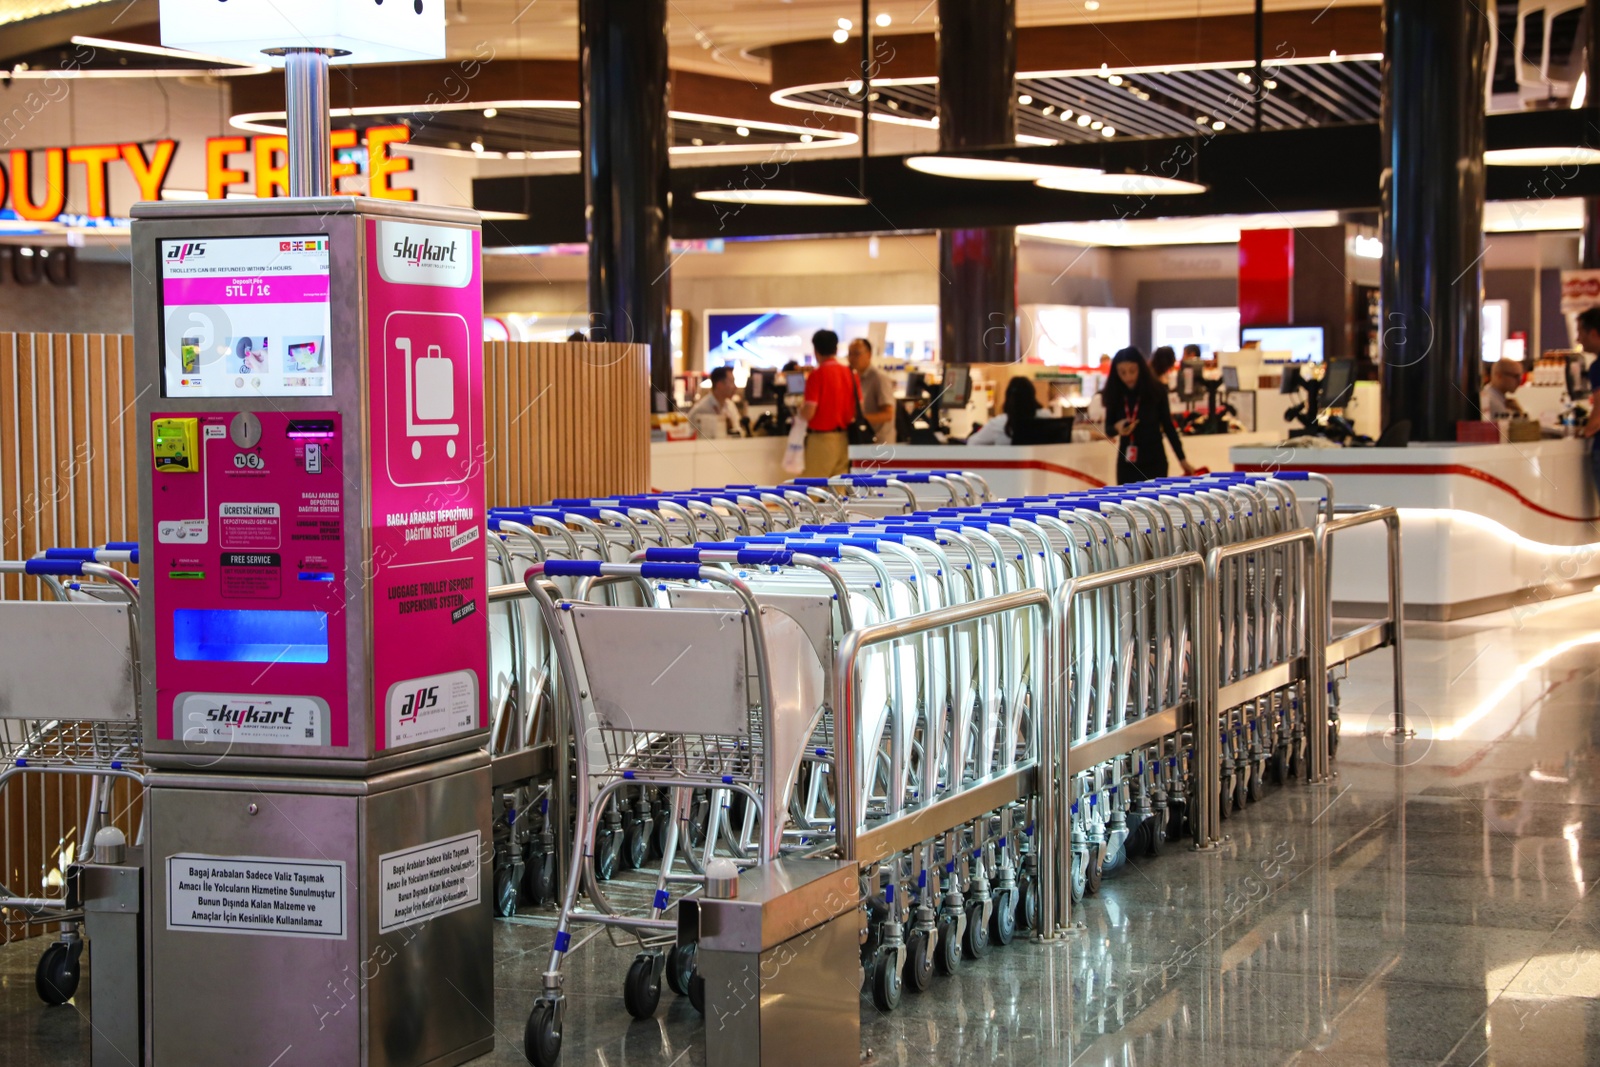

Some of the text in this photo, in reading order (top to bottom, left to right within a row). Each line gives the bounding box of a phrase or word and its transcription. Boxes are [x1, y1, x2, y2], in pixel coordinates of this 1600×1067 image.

[0, 124, 418, 222] UTY FREE
[393, 236, 457, 265] skykart
[226, 284, 270, 296] 5TL / 1€
[232, 278, 252, 286] Deposit
[236, 456, 244, 464] TL
[224, 504, 274, 515] ÜCRETSİZ HİZMET
[386, 506, 474, 526] BAGAJ ARABASI DEPOZİTOLU
[405, 522, 458, 541] DAĞITIM SİSTEMİ
[230, 555, 271, 564] FREE SERVICE
[388, 577, 474, 600] LUGGAGE TROLLEY DEPOSIT
[399, 594, 464, 614] DISPENSING SYSTEM
[452, 602, 474, 620] FREE SERVICE
[206, 704, 294, 728] skykart
[392, 864, 406, 875] Bagaj
[426, 855, 442, 866] Sadece
[442, 852, 452, 860] Valiz
[452, 846, 469, 858] Taşımak
[189, 867, 324, 884] Bagaj Arabaları Sadece Valiz Taşımak
[386, 880, 400, 891] Amacı
[430, 866, 450, 880] Hizmetine
[178, 880, 336, 900] Amacı İle Yolcuların Hizmetine Sunulmuştur
[398, 892, 412, 902] Bunun
[428, 882, 440, 892] Kalan
[442, 878, 460, 890] Malzeme
[198, 896, 316, 912] Bunun Dışında Kalan Malzeme ve
[394, 906, 412, 918] Amaçlar
[192, 910, 322, 927] Amaçlar İçin Kesinlikle Kullanılamaz
